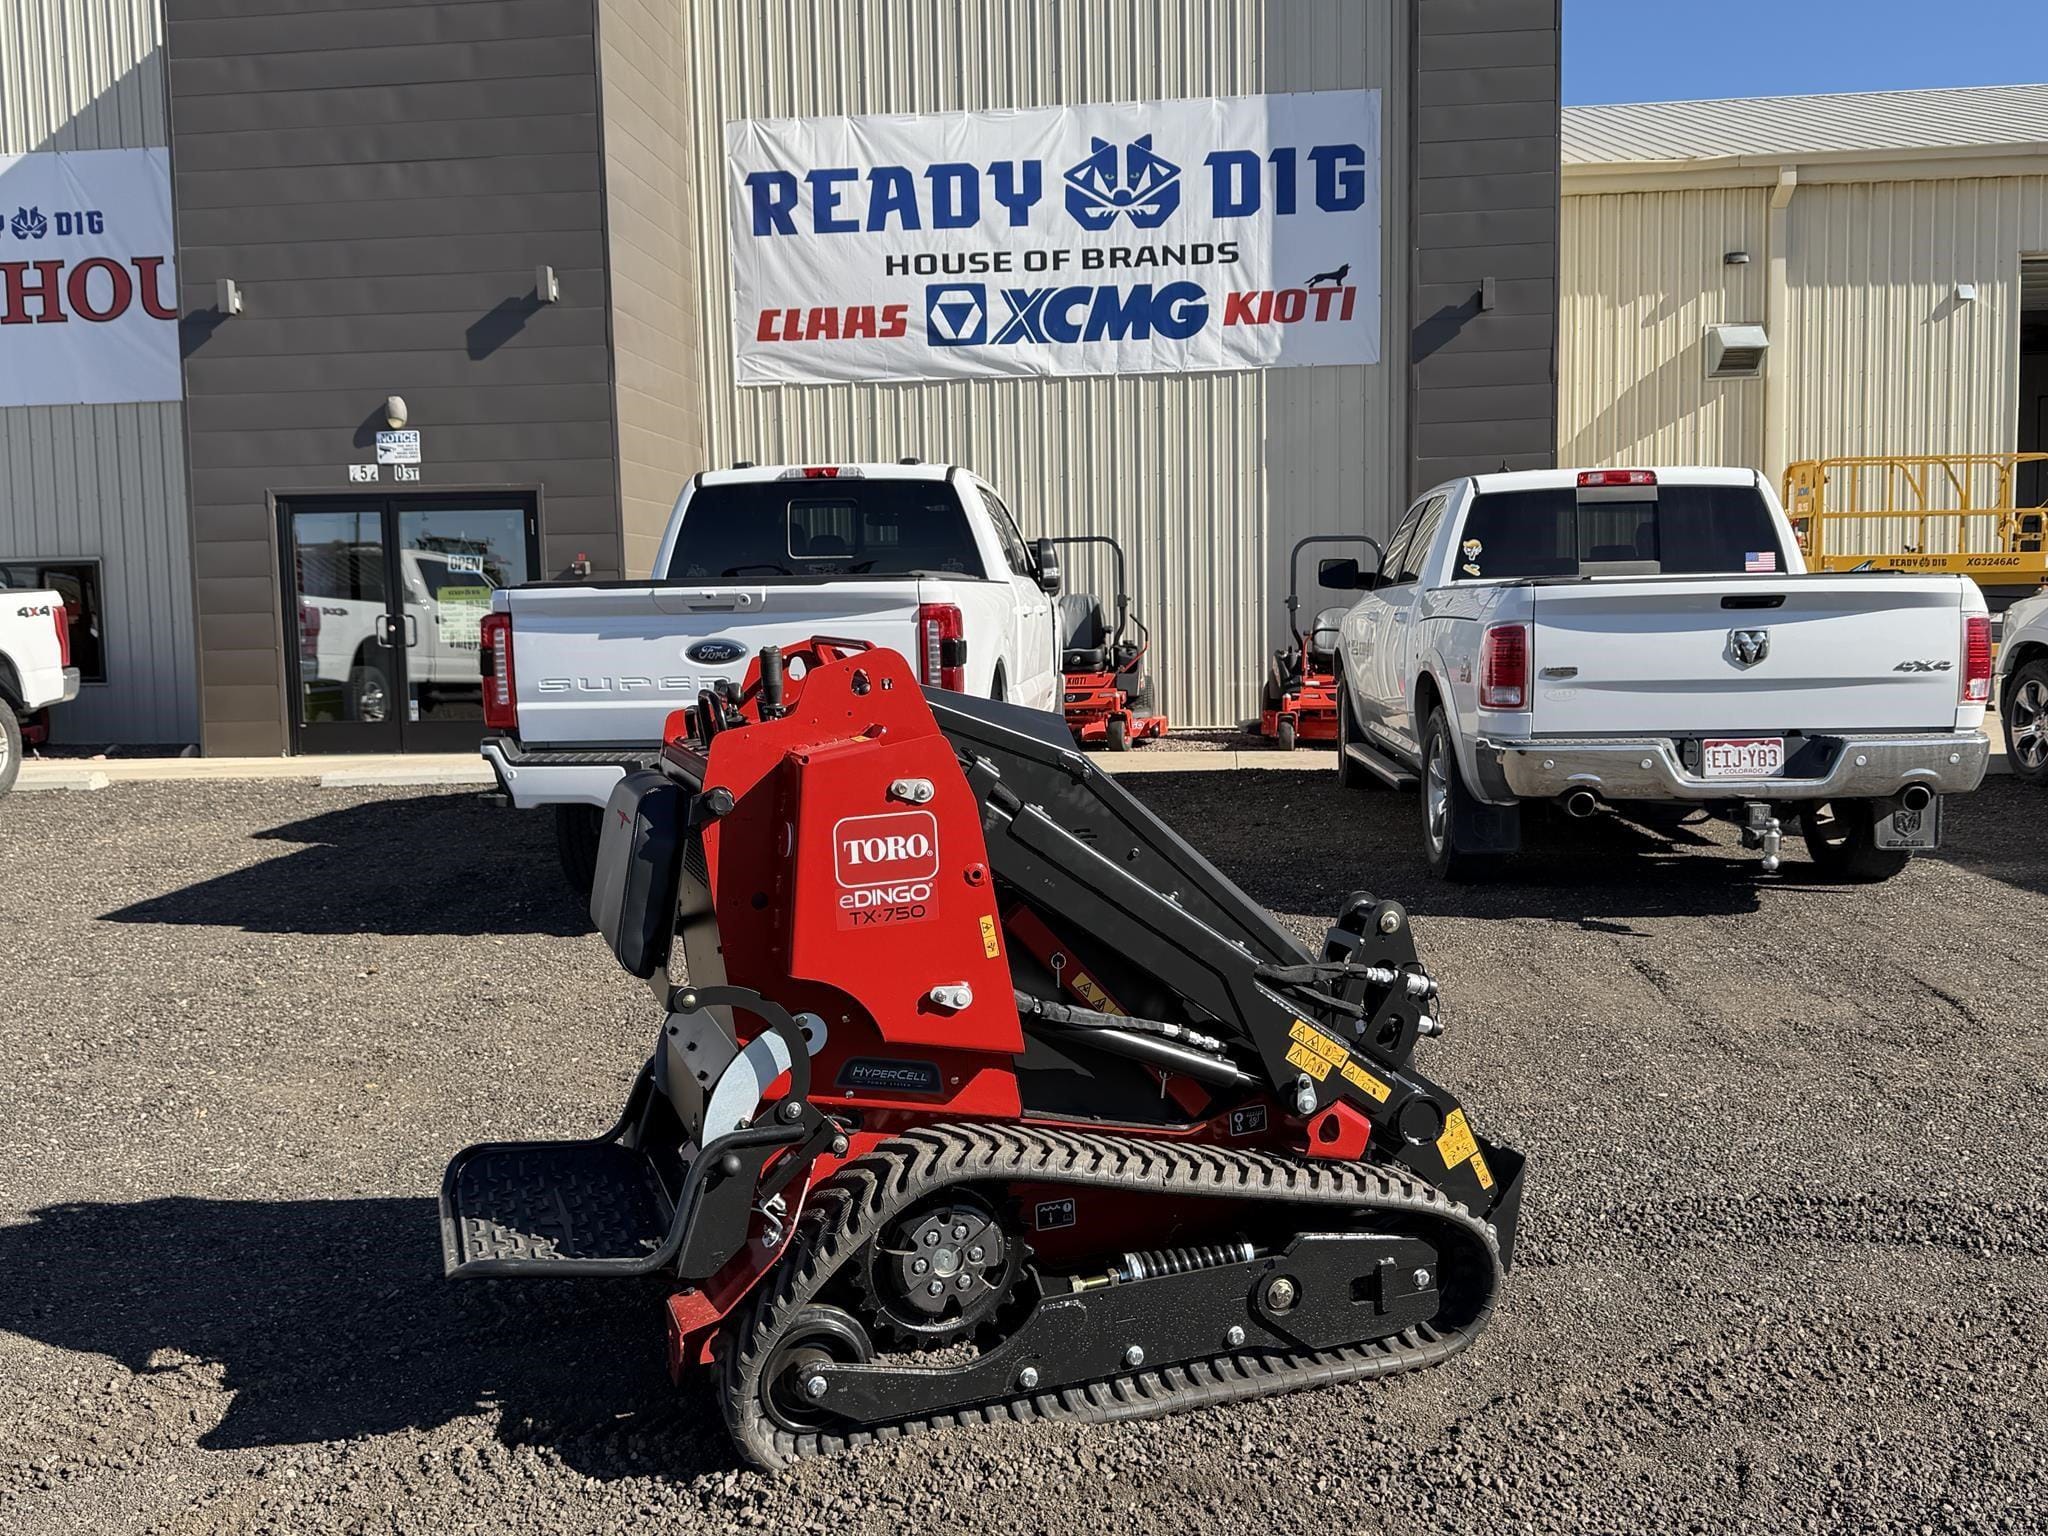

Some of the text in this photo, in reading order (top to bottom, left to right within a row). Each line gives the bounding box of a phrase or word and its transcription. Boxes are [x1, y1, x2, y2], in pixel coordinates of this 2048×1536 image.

[744, 144, 1365, 236] READY DIG
[54, 211, 104, 235] DIG
[886, 242, 1240, 276] HOUSE OF BRANDS
[987, 281, 1209, 345] XCMG
[1223, 286, 1357, 327] KIOTI
[756, 304, 908, 342] CLAAS
[377, 431, 418, 443] NOTICE
[449, 556, 480, 571] OPEN
[1889, 558, 1947, 567] READY DIG
[1966, 557, 2021, 567] XG3246AC
[699, 645, 731, 660] Ford
[1066, 677, 1087, 685] KIOTI
[843, 833, 930, 865] TORO
[839, 884, 931, 909] eDINGO
